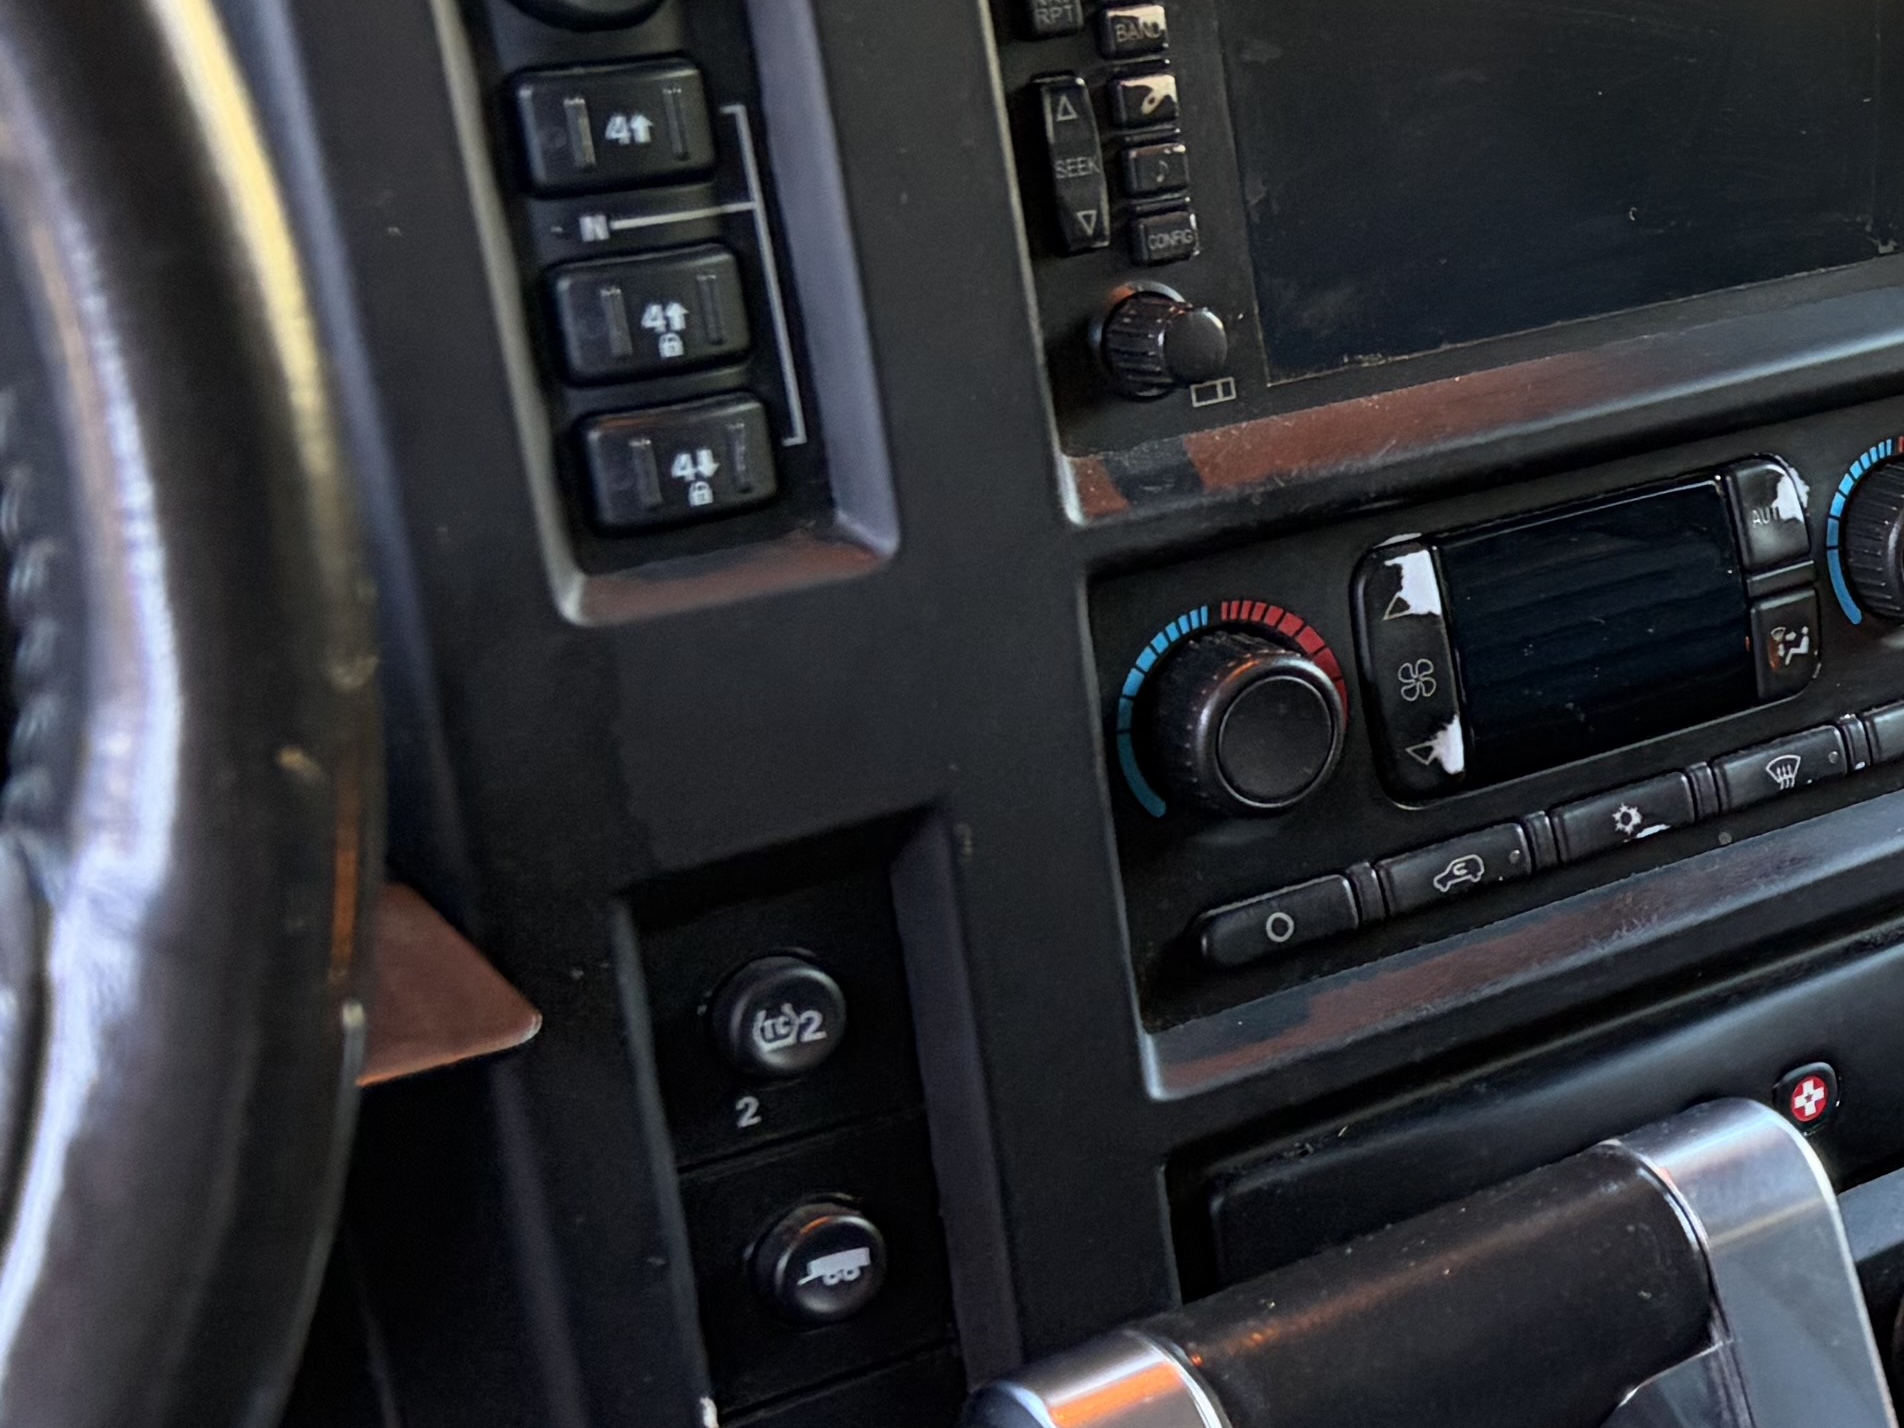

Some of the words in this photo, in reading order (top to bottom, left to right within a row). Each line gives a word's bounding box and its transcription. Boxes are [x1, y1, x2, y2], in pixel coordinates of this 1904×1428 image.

[1034, 5, 1074, 24] RPT
[1116, 21, 1161, 43] BAND
[605, 113, 631, 145] 4
[1055, 155, 1100, 179] SEEK
[1148, 229, 1194, 250] CONFIG
[641, 303, 668, 333] 4
[671, 453, 698, 482] 4
[735, 1095, 762, 1129] 2
